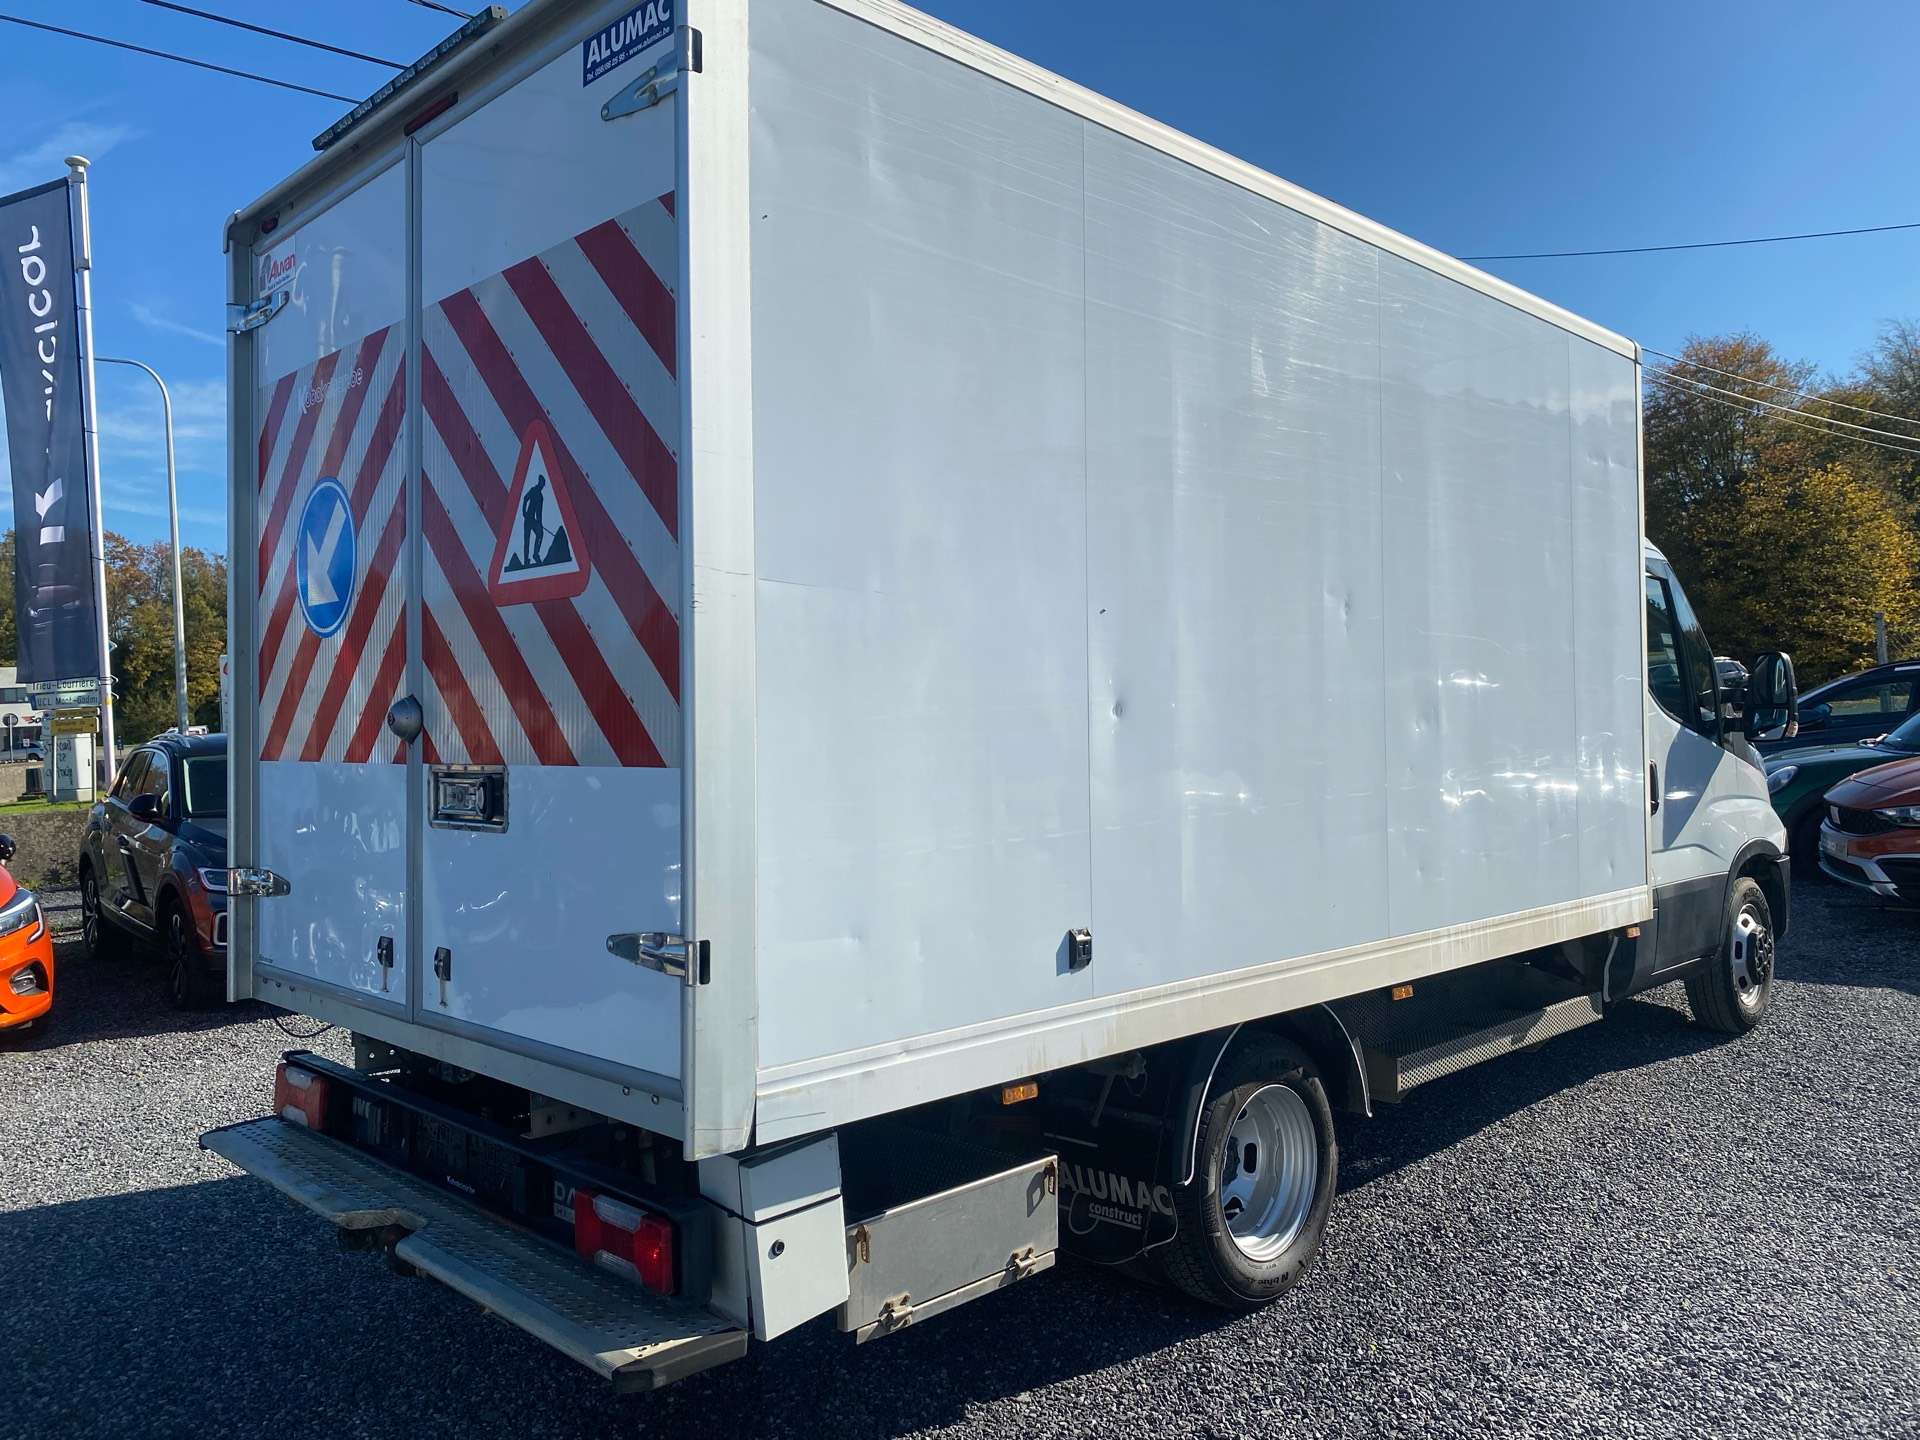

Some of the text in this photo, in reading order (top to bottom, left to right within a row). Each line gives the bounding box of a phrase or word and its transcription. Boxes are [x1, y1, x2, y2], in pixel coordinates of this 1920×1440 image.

[586, 0, 671, 69] ALUMAC
[1059, 1161, 1174, 1216] ALUMAC
[1088, 1201, 1144, 1226] construct
